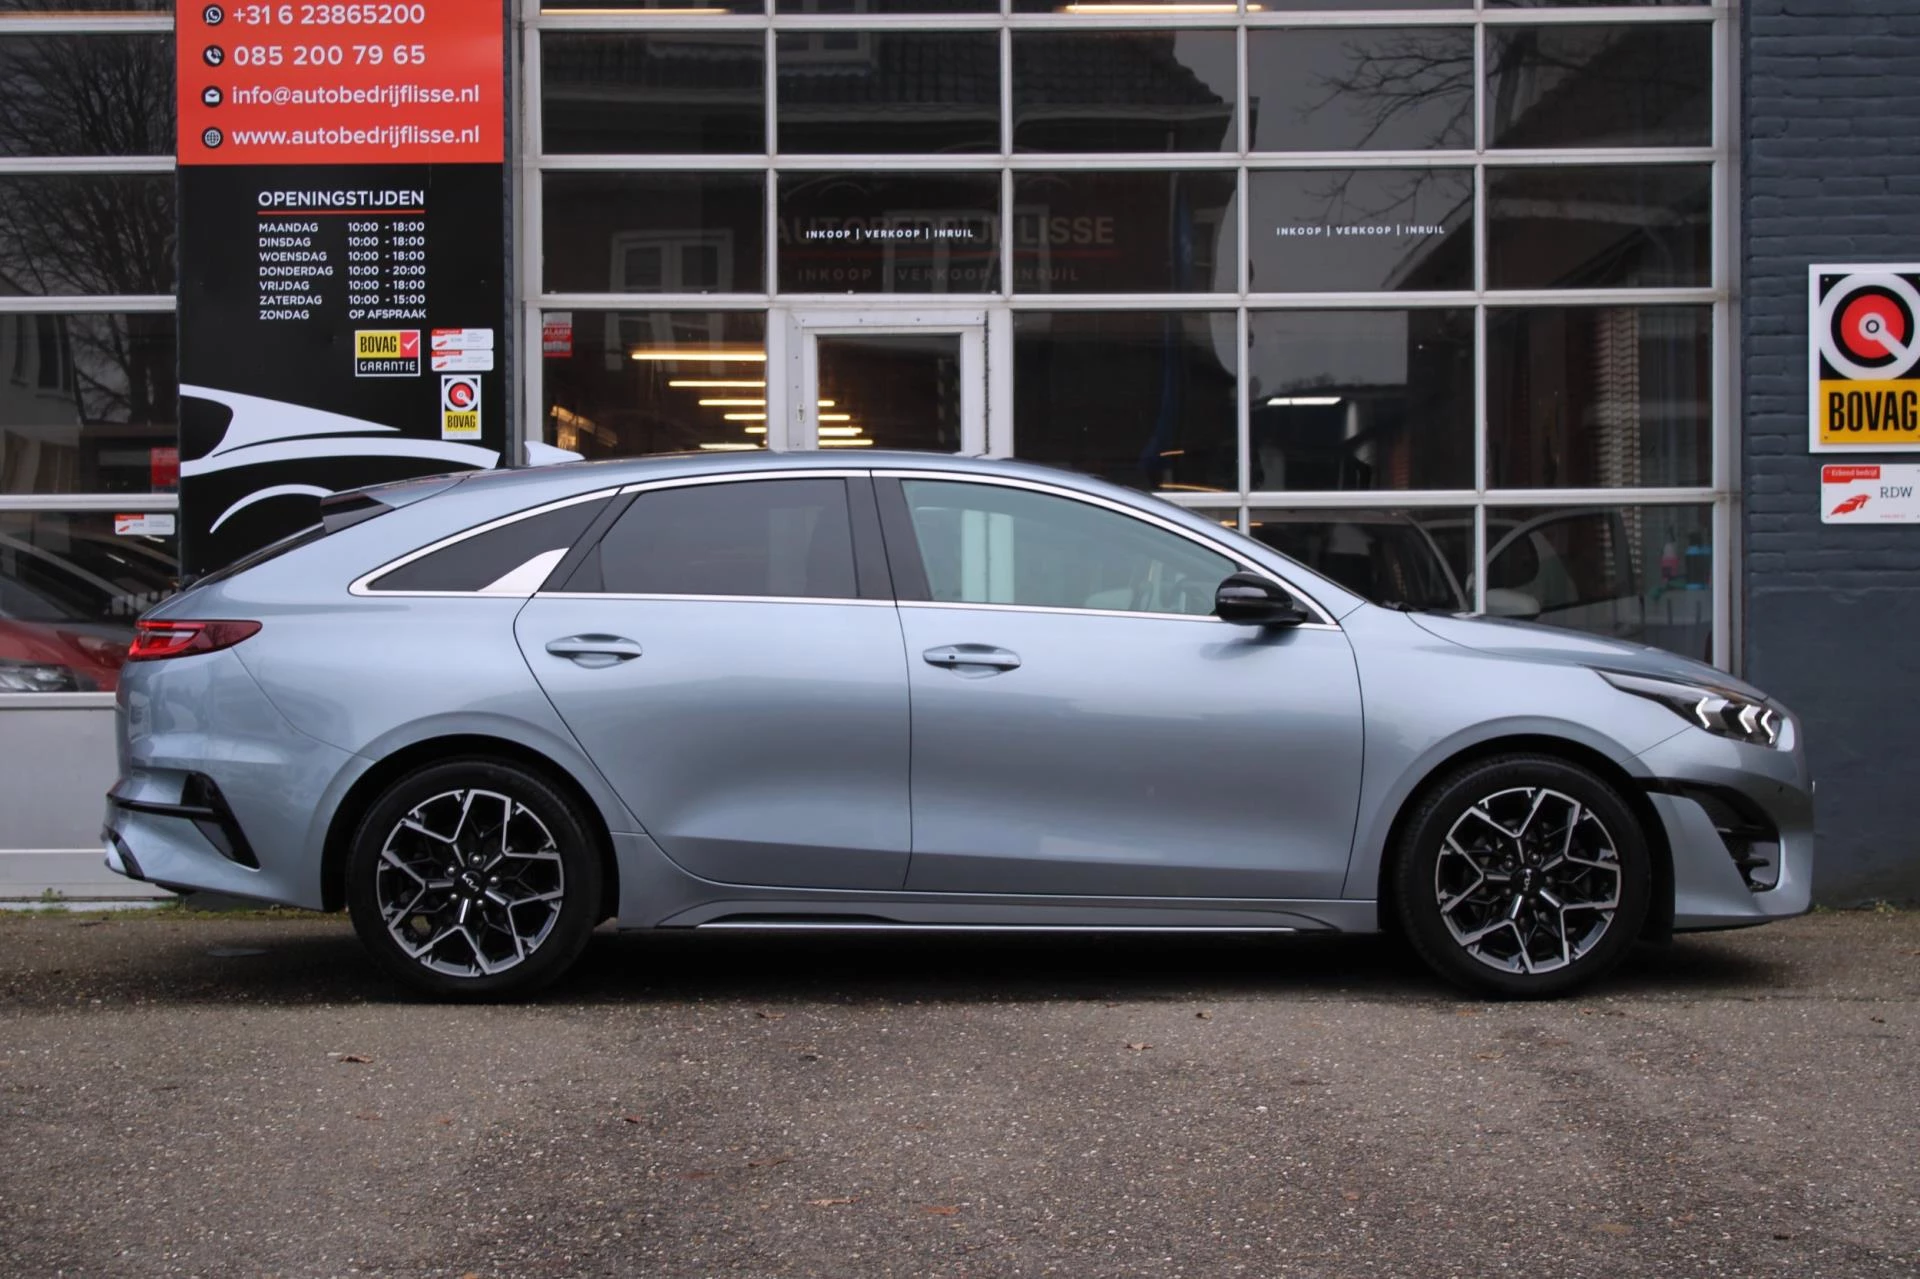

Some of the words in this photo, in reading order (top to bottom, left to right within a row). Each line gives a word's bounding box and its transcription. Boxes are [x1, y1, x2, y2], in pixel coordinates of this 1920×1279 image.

[233, 5, 270, 25] +31
[278, 5, 293, 24] 6
[301, 4, 425, 24] 23865200
[234, 46, 283, 65] 085
[294, 45, 343, 65] 200
[353, 45, 383, 64] 79
[394, 45, 425, 64] 65
[233, 85, 479, 107] info@autobedrijflisse.nl
[232, 125, 479, 148] www.autobedrijflisse.nl
[258, 191, 423, 206] OPENINGSTIJDEN
[259, 223, 318, 232] MAANDAG
[348, 222, 378, 232] 10:00
[393, 222, 424, 231] 18:00
[1020, 216, 1114, 244] LISSE
[1277, 227, 1321, 235] INKOOP
[1336, 226, 1391, 234] VERKOOP
[1406, 226, 1444, 234] INRUIL
[806, 230, 850, 238] INKOOP
[865, 230, 920, 238] VERKOOP
[934, 229, 973, 237] INRUIL
[259, 237, 311, 247] DINSDAG
[349, 237, 378, 246] 10:00
[393, 237, 424, 246] 18:00
[260, 252, 327, 261] WOENSDAG
[348, 251, 379, 261] 10:00
[393, 251, 424, 260] 18:00
[260, 266, 333, 276] DONDERDAG
[349, 266, 379, 275] 10:00
[393, 265, 425, 275] 20:00
[260, 281, 309, 290] VRIJDAG
[349, 280, 379, 290] 10:00
[394, 280, 425, 289] 18:00
[260, 295, 322, 305] ZATERDAG
[349, 295, 379, 304] 10:00
[394, 295, 425, 304] 15:00
[260, 310, 309, 319] ZONDAG
[349, 310, 365, 319] OP
[368, 309, 426, 318] AFSPRAAK
[360, 336, 396, 352] BOVAG
[360, 361, 415, 371] GARANTIE
[1829, 391, 1917, 431] BOVAG
[448, 415, 475, 428] BOVAG
[1880, 486, 1913, 498] RDW
